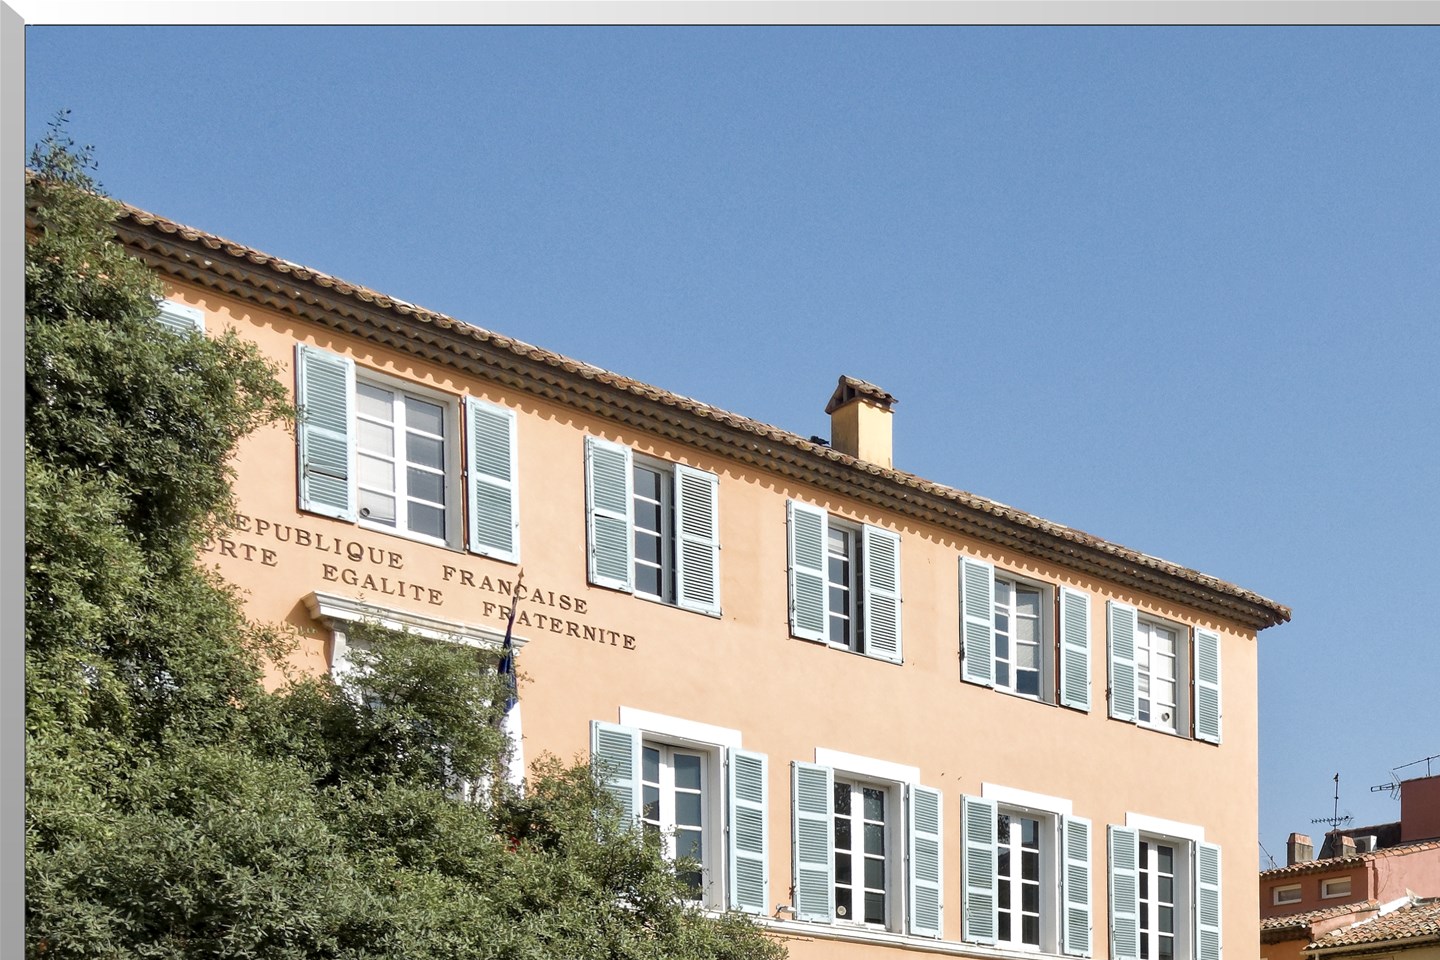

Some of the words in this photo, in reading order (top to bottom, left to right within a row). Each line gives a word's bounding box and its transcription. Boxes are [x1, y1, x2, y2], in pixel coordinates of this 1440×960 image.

[234, 514, 404, 570] EPUBLIQUE
[199, 536, 278, 567] ERTE
[322, 563, 444, 606] EGALITE
[483, 601, 637, 651] FRATERNITE
